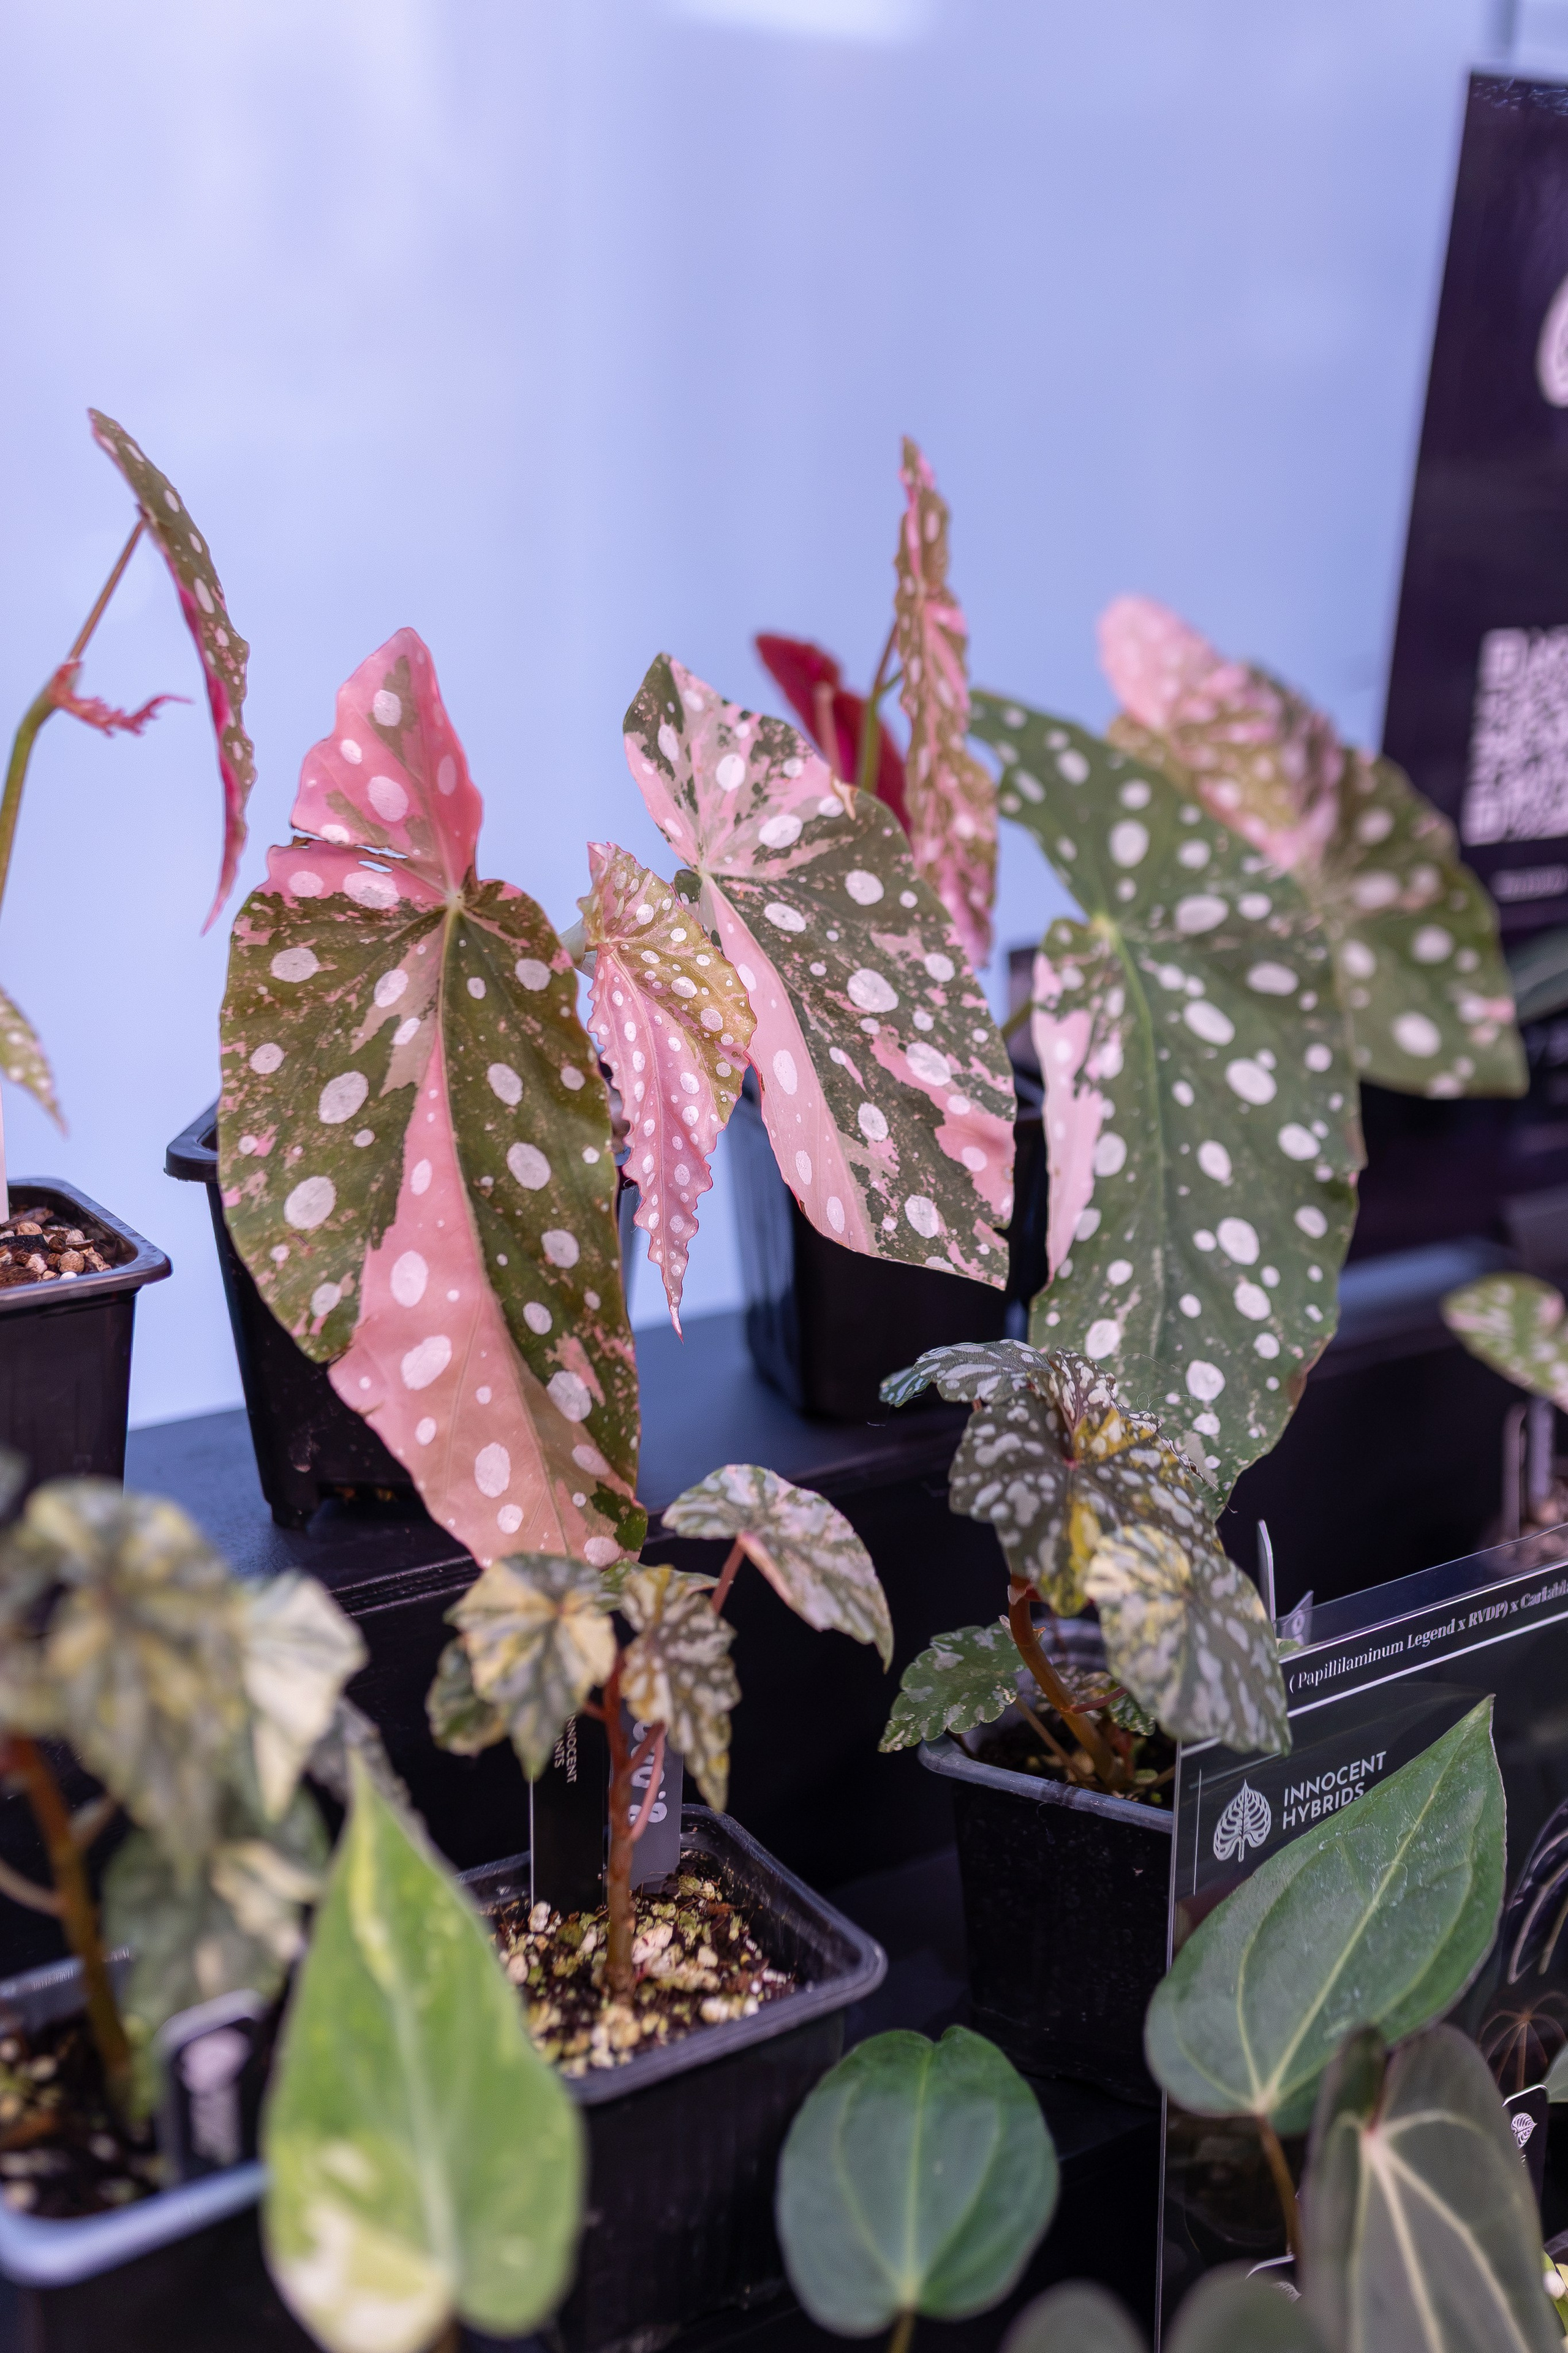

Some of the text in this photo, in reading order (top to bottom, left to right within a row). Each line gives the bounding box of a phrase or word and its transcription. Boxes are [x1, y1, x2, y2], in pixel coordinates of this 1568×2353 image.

[1407, 1618, 1455, 1649] Legend
[1457, 1618, 1466, 1632] x
[1468, 1600, 1509, 1628] RVDP)
[1509, 1600, 1520, 1614] x
[567, 1715, 577, 1783] NNOCENT
[1284, 1750, 1387, 1807] INNOCENT
[1283, 1781, 1365, 1830] HYBRIDS
